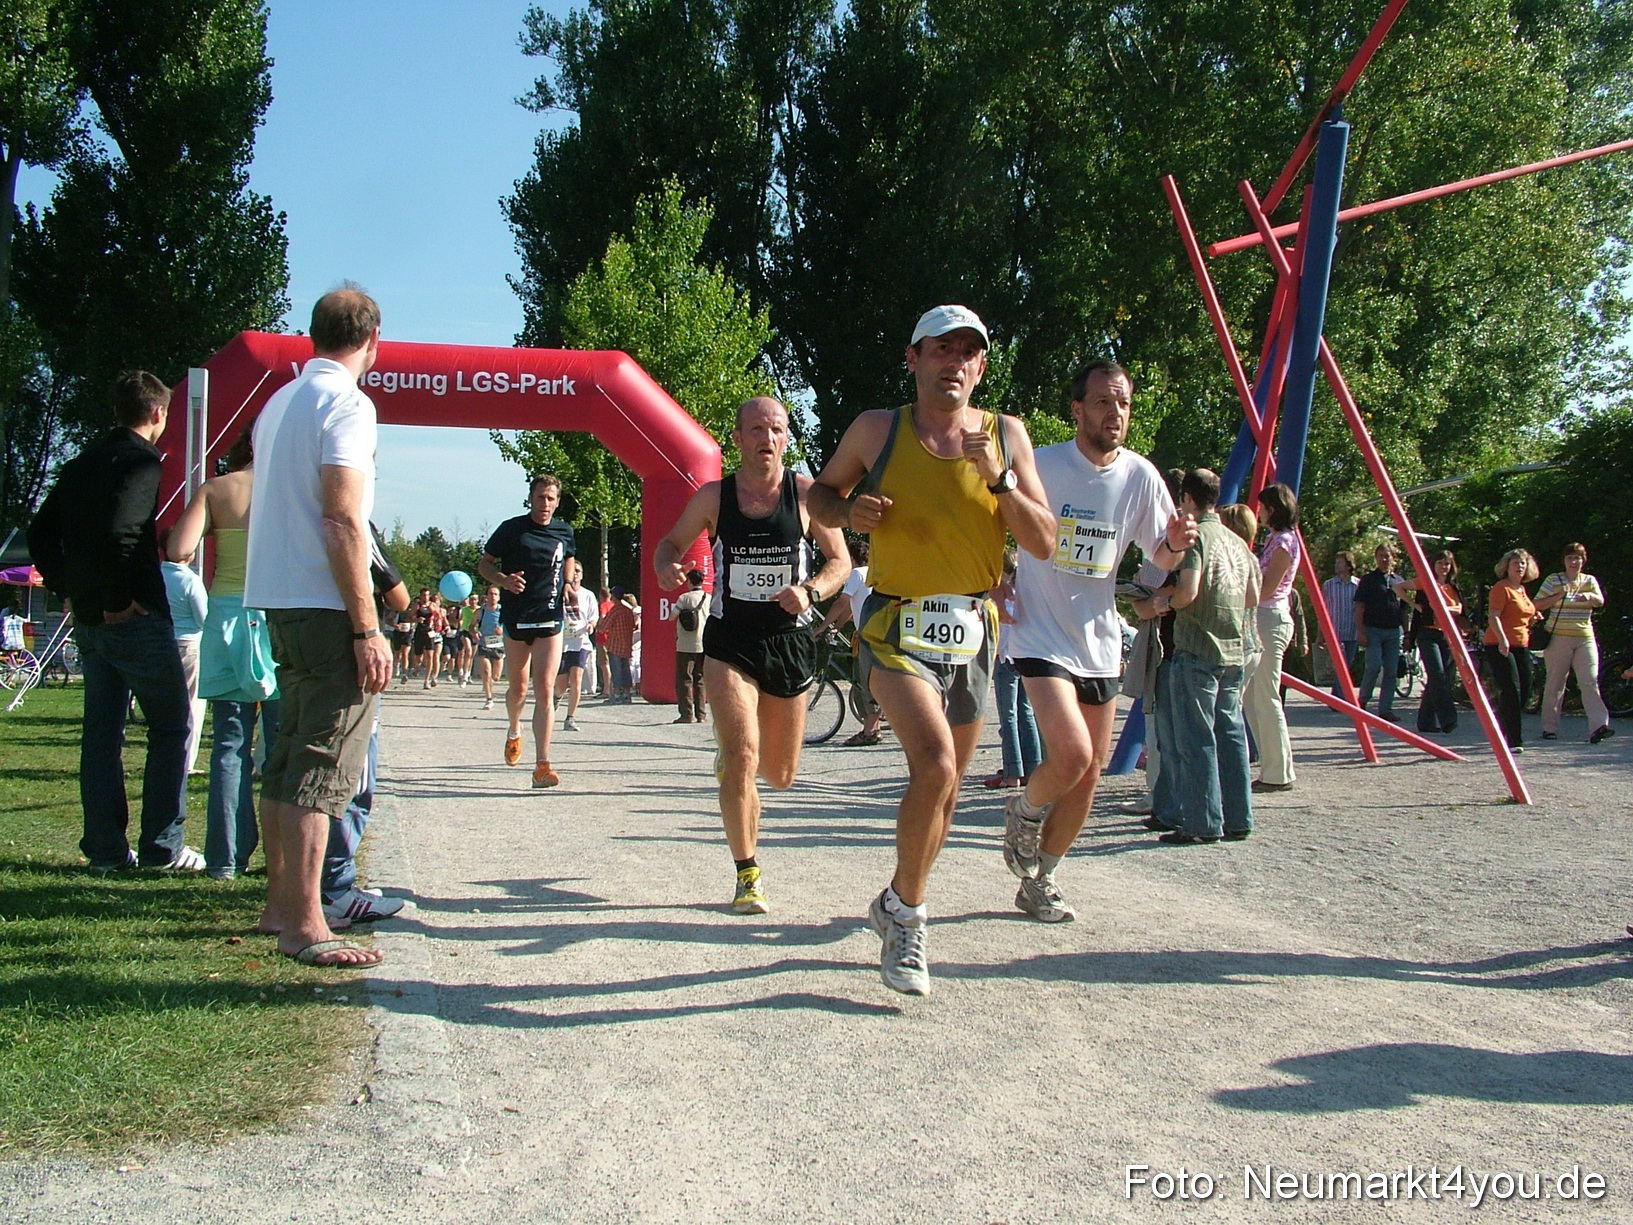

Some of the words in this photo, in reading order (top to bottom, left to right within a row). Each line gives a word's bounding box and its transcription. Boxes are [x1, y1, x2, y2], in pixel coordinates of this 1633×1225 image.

[456, 371, 577, 395] LGS-Park
[1075, 525, 1117, 540] Burkhard
[730, 546, 747, 554] LLC
[748, 545, 792, 554] Marathon
[1060, 538, 1068, 548] A
[1074, 543, 1094, 561] 71
[734, 555, 788, 564] Regensburg
[746, 573, 784, 587] 3591
[922, 600, 949, 613] Akin
[905, 617, 914, 628] B
[922, 622, 965, 645] 490
